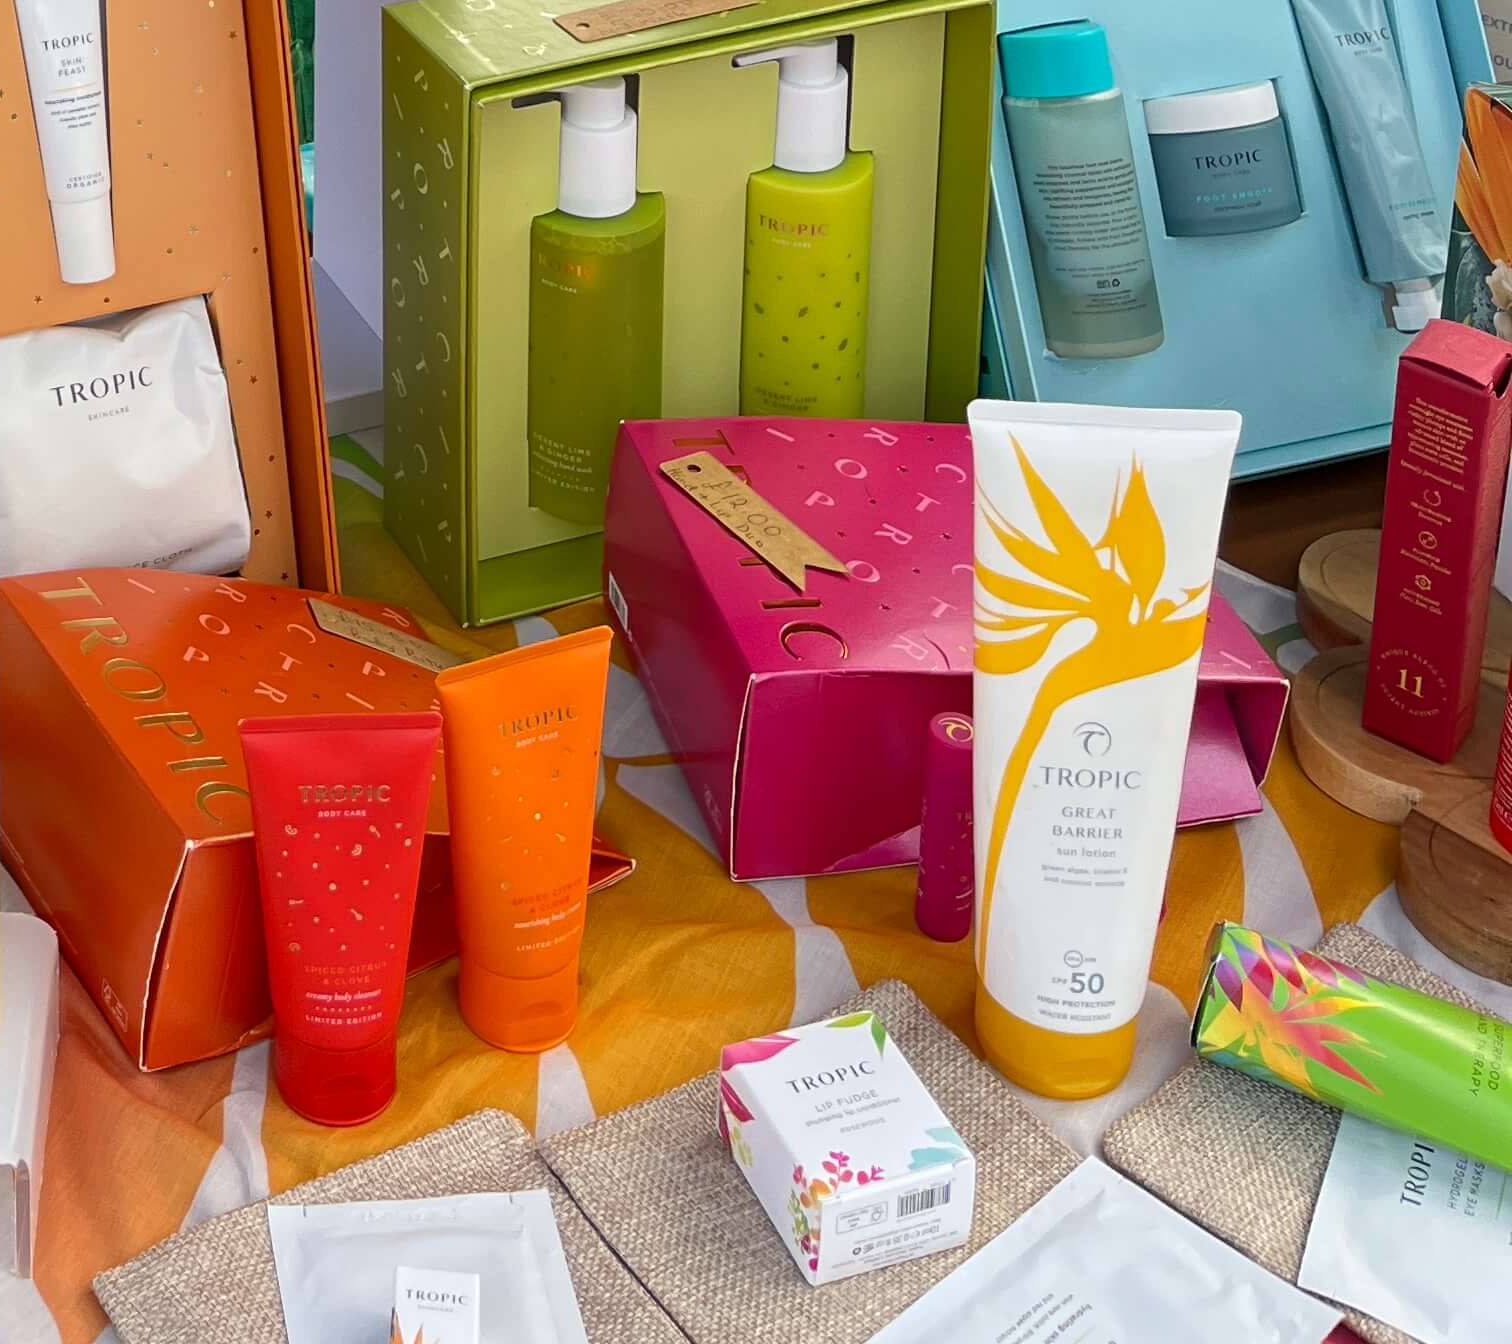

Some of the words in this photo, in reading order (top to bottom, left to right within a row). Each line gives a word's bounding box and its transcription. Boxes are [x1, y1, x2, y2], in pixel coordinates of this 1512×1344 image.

[42, 32, 95, 53] TROPIC
[1335, 26, 1391, 49] TROPIC
[58, 65, 88, 78] FEAST
[60, 56, 83, 68] SKIN
[1192, 148, 1263, 170] TROPIC
[759, 213, 830, 237] TROPIC
[49, 366, 153, 408] TROPIC
[88, 405, 130, 421] SKINCARE
[154, 547, 193, 567] CLOTH
[1395, 668, 1425, 699] 11
[38, 575, 250, 825] TROPIC
[500, 706, 578, 738] TROPIC
[1040, 765, 1143, 790] TROPIC
[298, 783, 392, 803] TROPIC
[318, 809, 342, 818] BODY
[344, 808, 367, 817] CARE
[1061, 806, 1118, 820] GREAT
[1052, 824, 1124, 840] BARRIER
[1056, 847, 1078, 857] sun
[1081, 847, 1117, 858] lotion
[304, 964, 344, 975] SPICED
[334, 975, 371, 986] CLOVE
[1069, 971, 1105, 995] 50
[1062, 999, 1116, 1009] PROTECTION
[305, 1013, 343, 1026] LIMITED
[346, 1012, 383, 1025] EDITION
[786, 1059, 877, 1095] TROPIC
[814, 1101, 834, 1114] LIP
[836, 1088, 880, 1108] FUDGE
[1399, 1141, 1436, 1207] TROPI
[1447, 1157, 1470, 1211] HYDROGEL
[1470, 1161, 1487, 1197] MASKS
[1464, 1194, 1479, 1217] EYE
[405, 1287, 470, 1306] TROPIC
